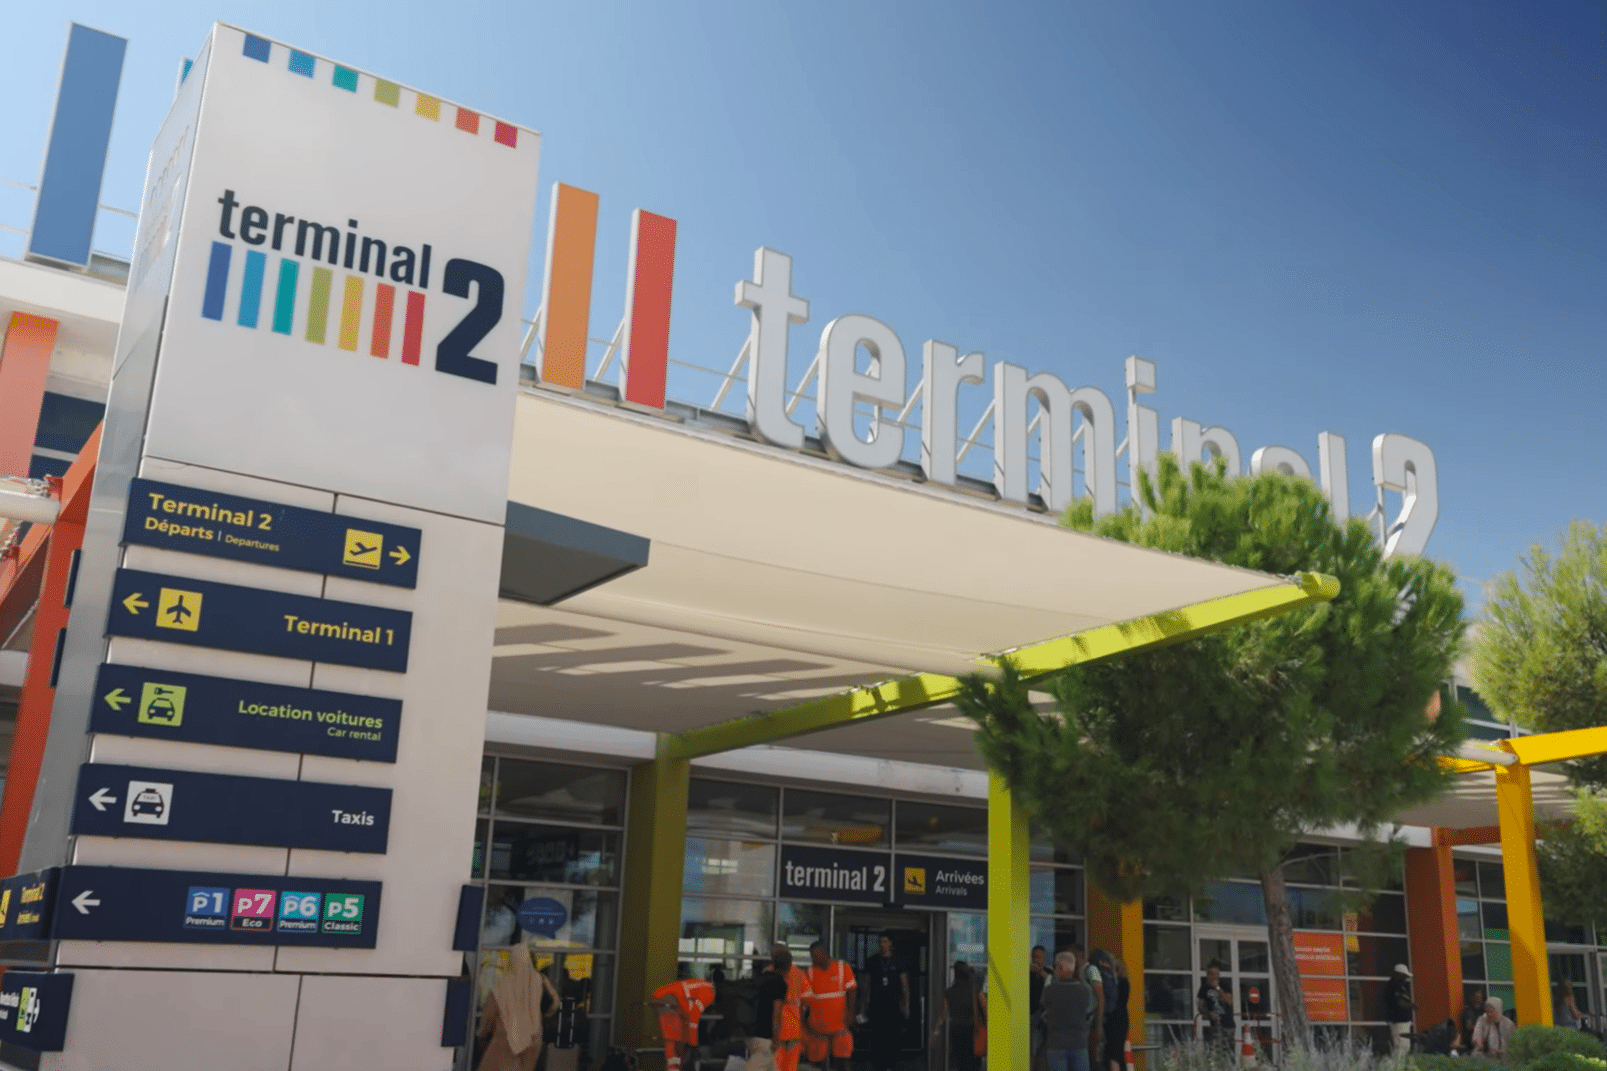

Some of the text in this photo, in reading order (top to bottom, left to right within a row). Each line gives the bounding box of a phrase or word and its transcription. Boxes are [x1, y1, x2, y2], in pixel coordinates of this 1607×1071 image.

[217, 189, 505, 385] terminal 2
[1372, 433, 1438, 558] 2
[149, 492, 273, 531] Terminal 2
[144, 516, 280, 552] Départs Departures
[284, 614, 394, 646] Terminal 1
[238, 700, 384, 729] Location voitures
[327, 726, 382, 741] Car rental
[331, 809, 375, 826] Taxis
[785, 860, 886, 893] terminal 2
[935, 869, 985, 896] Arrivées Arrivals
[185, 916, 226, 926] Premium
[242, 918, 263, 927] Eco
[279, 919, 318, 929] Premium
[324, 921, 360, 931] Classic
